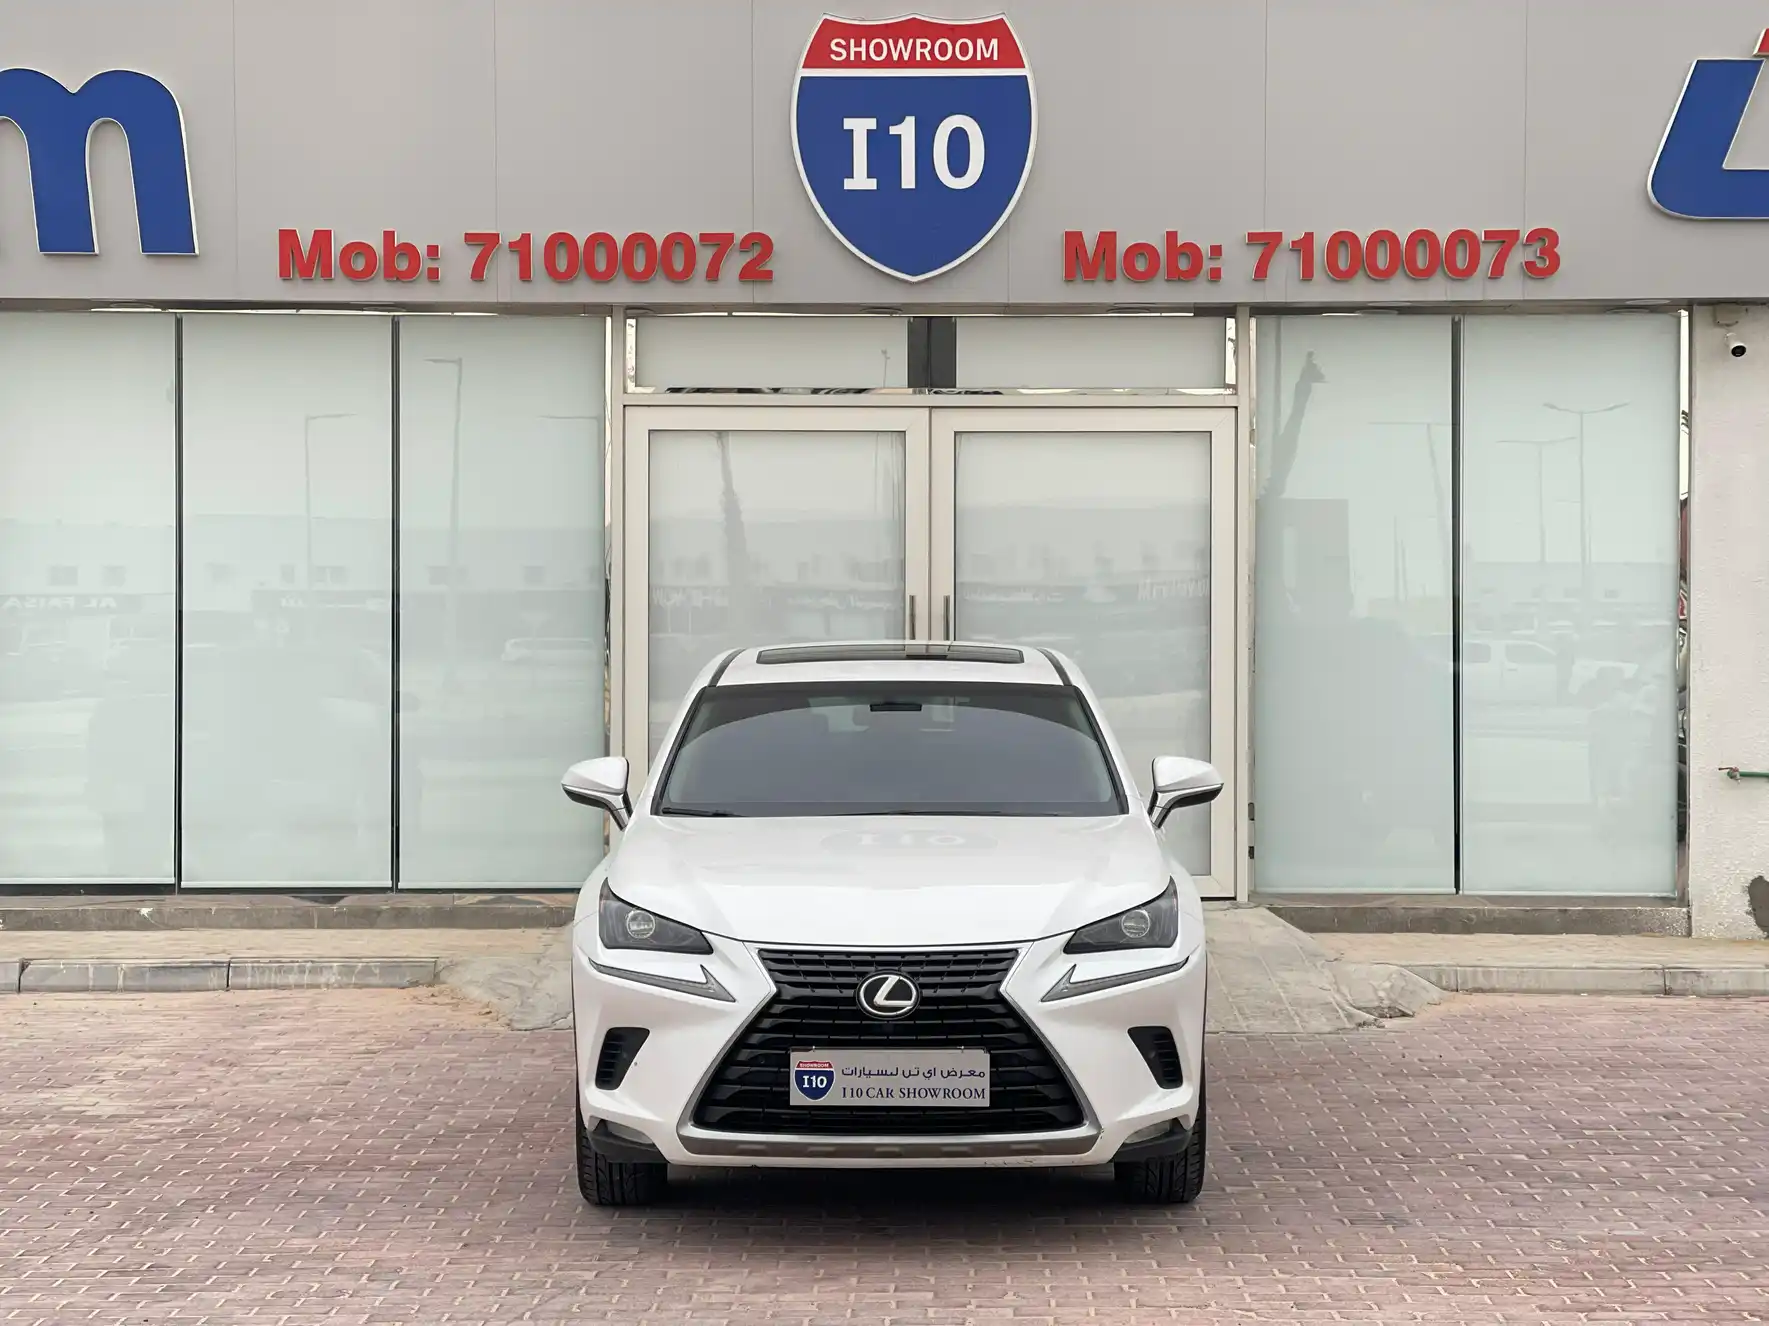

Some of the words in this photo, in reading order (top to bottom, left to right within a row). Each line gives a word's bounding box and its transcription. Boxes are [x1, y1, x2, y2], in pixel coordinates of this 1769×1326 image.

[829, 38, 999, 61] SHOWROOM
[843, 114, 986, 190] I10
[277, 228, 441, 281] Mob:
[463, 231, 775, 282] 71000072
[1063, 229, 1223, 282] Mob:
[1246, 228, 1562, 281] 71000073
[802, 1075, 828, 1089] I10
[940, 1067, 986, 1080] معرض
[865, 1086, 895, 1099] CAR
[899, 1087, 986, 1100] SHOWROOM
